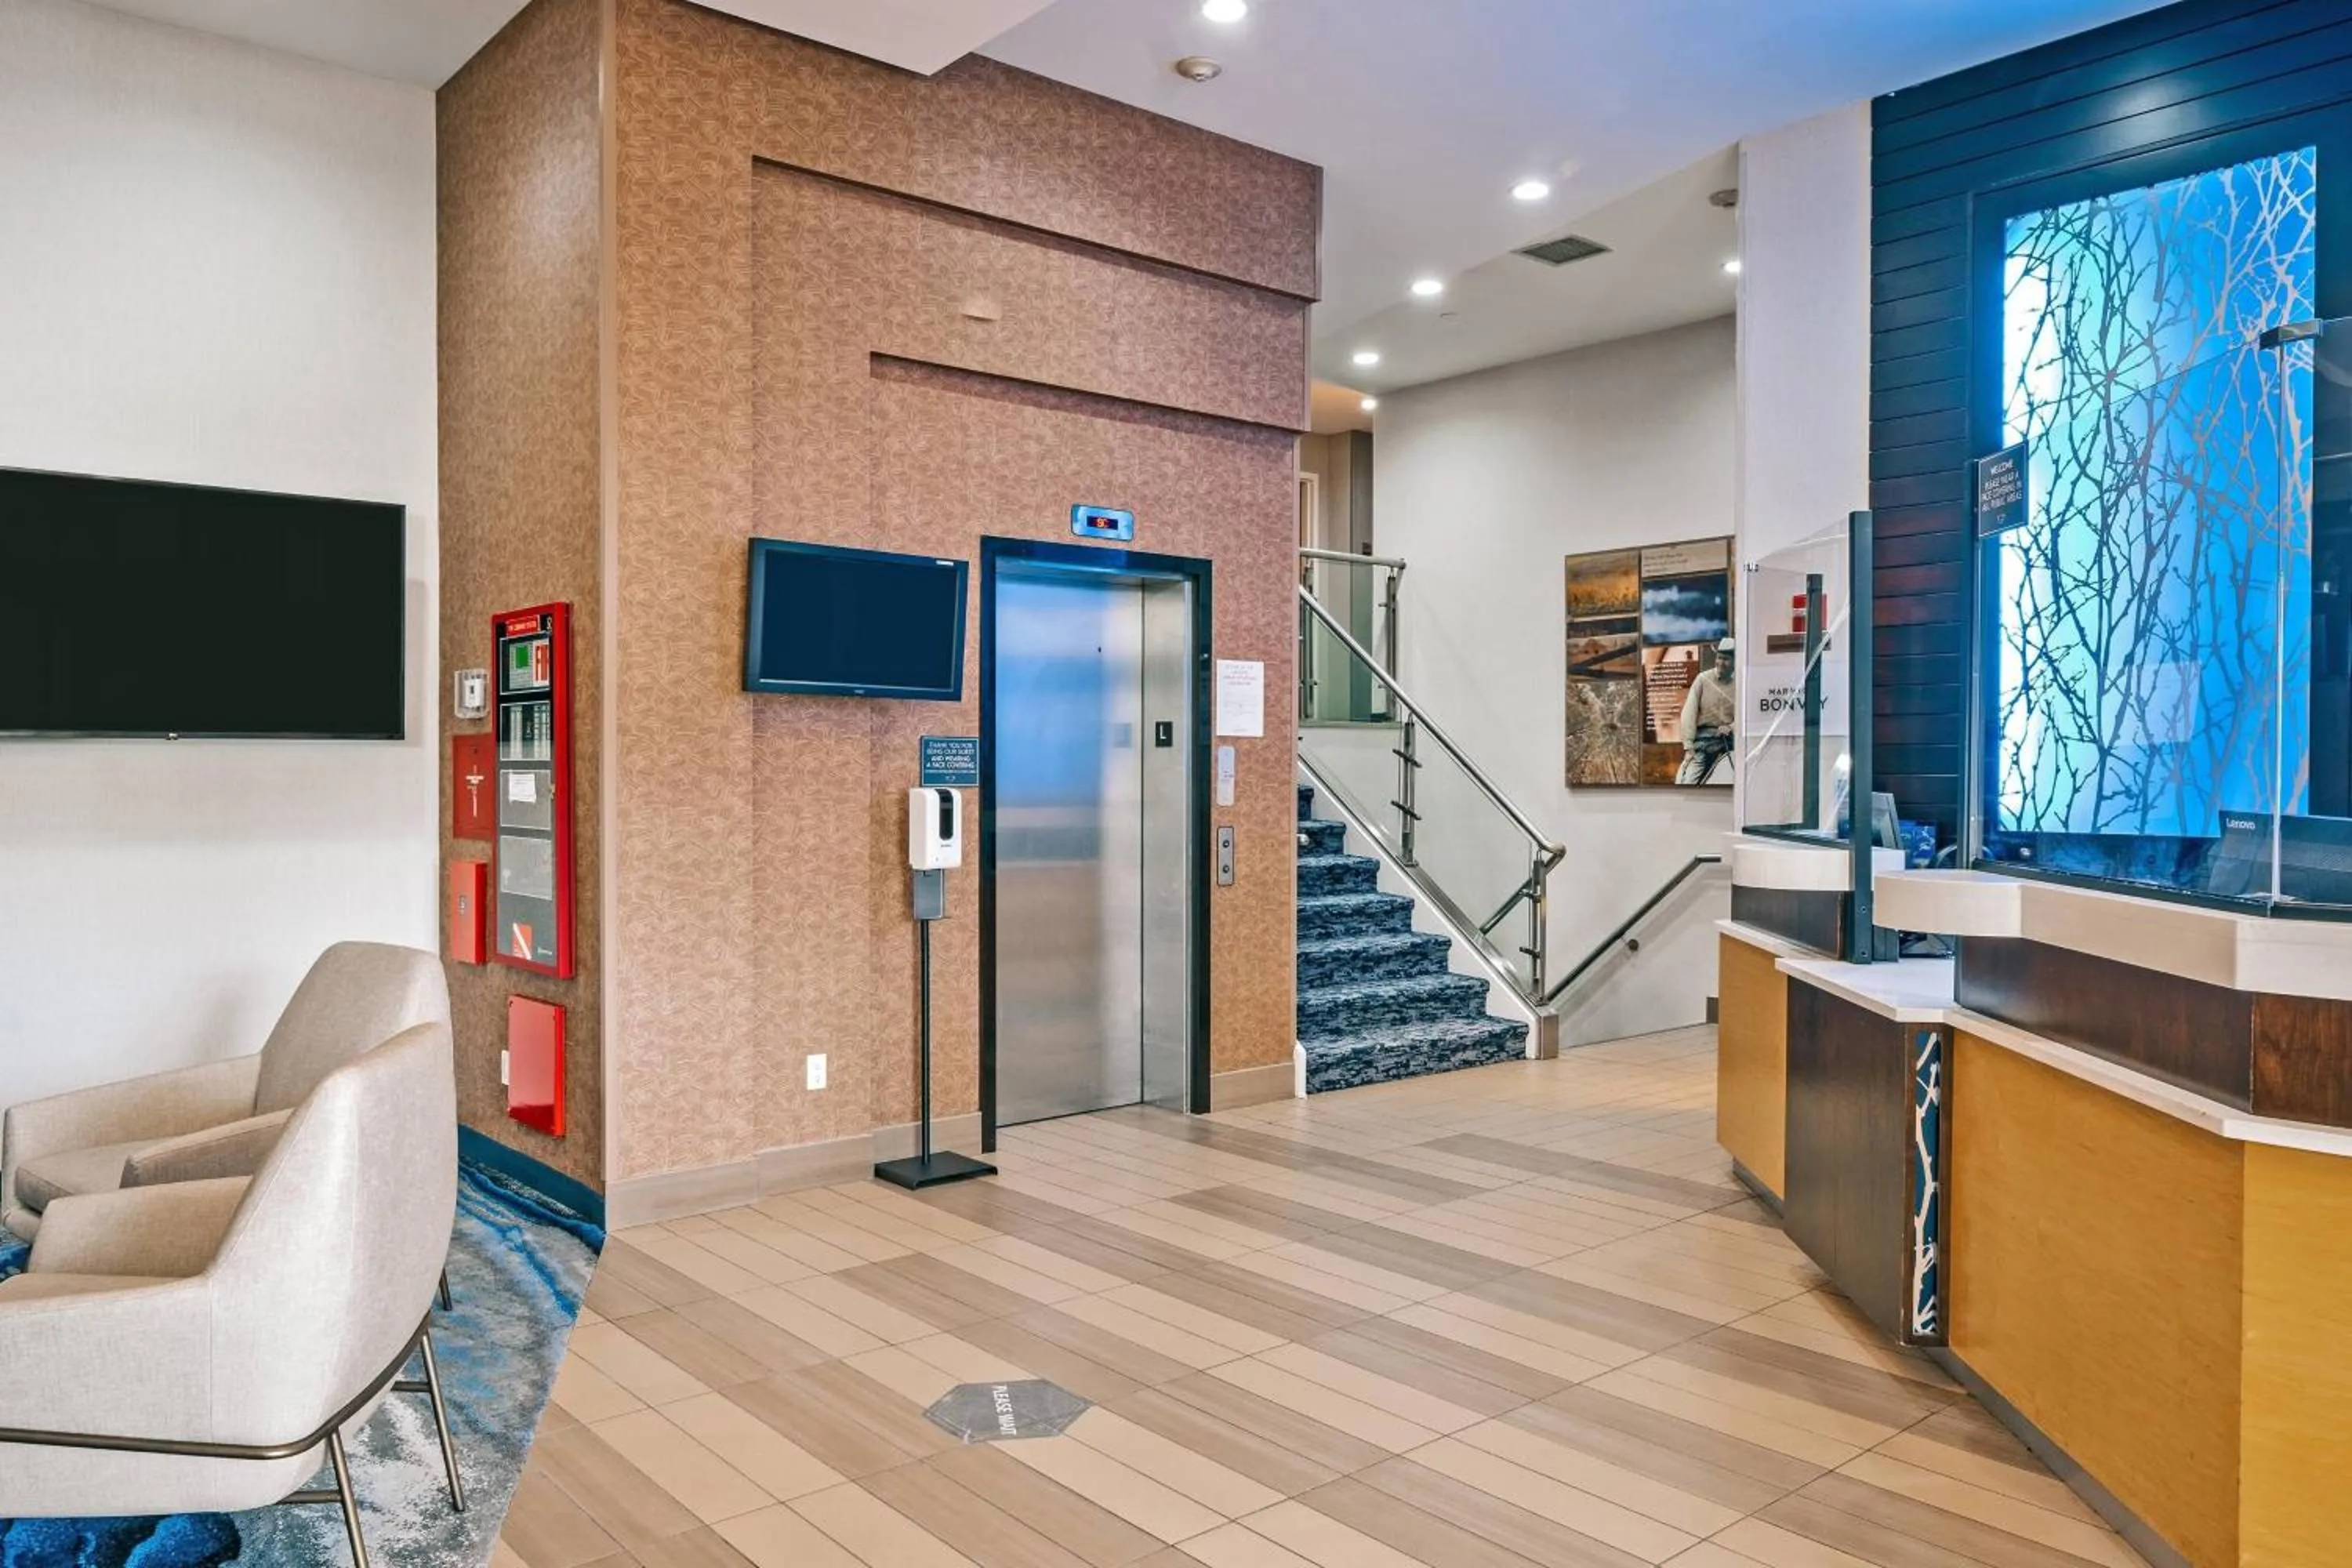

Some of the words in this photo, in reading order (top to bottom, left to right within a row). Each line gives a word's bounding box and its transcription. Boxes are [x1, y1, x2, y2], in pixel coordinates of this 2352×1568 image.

[1160, 724, 1167, 739] L
[2226, 818, 2256, 830] Lenovo
[991, 1385, 1014, 1414] PLEASE
[998, 1414, 1017, 1436] WAIT
